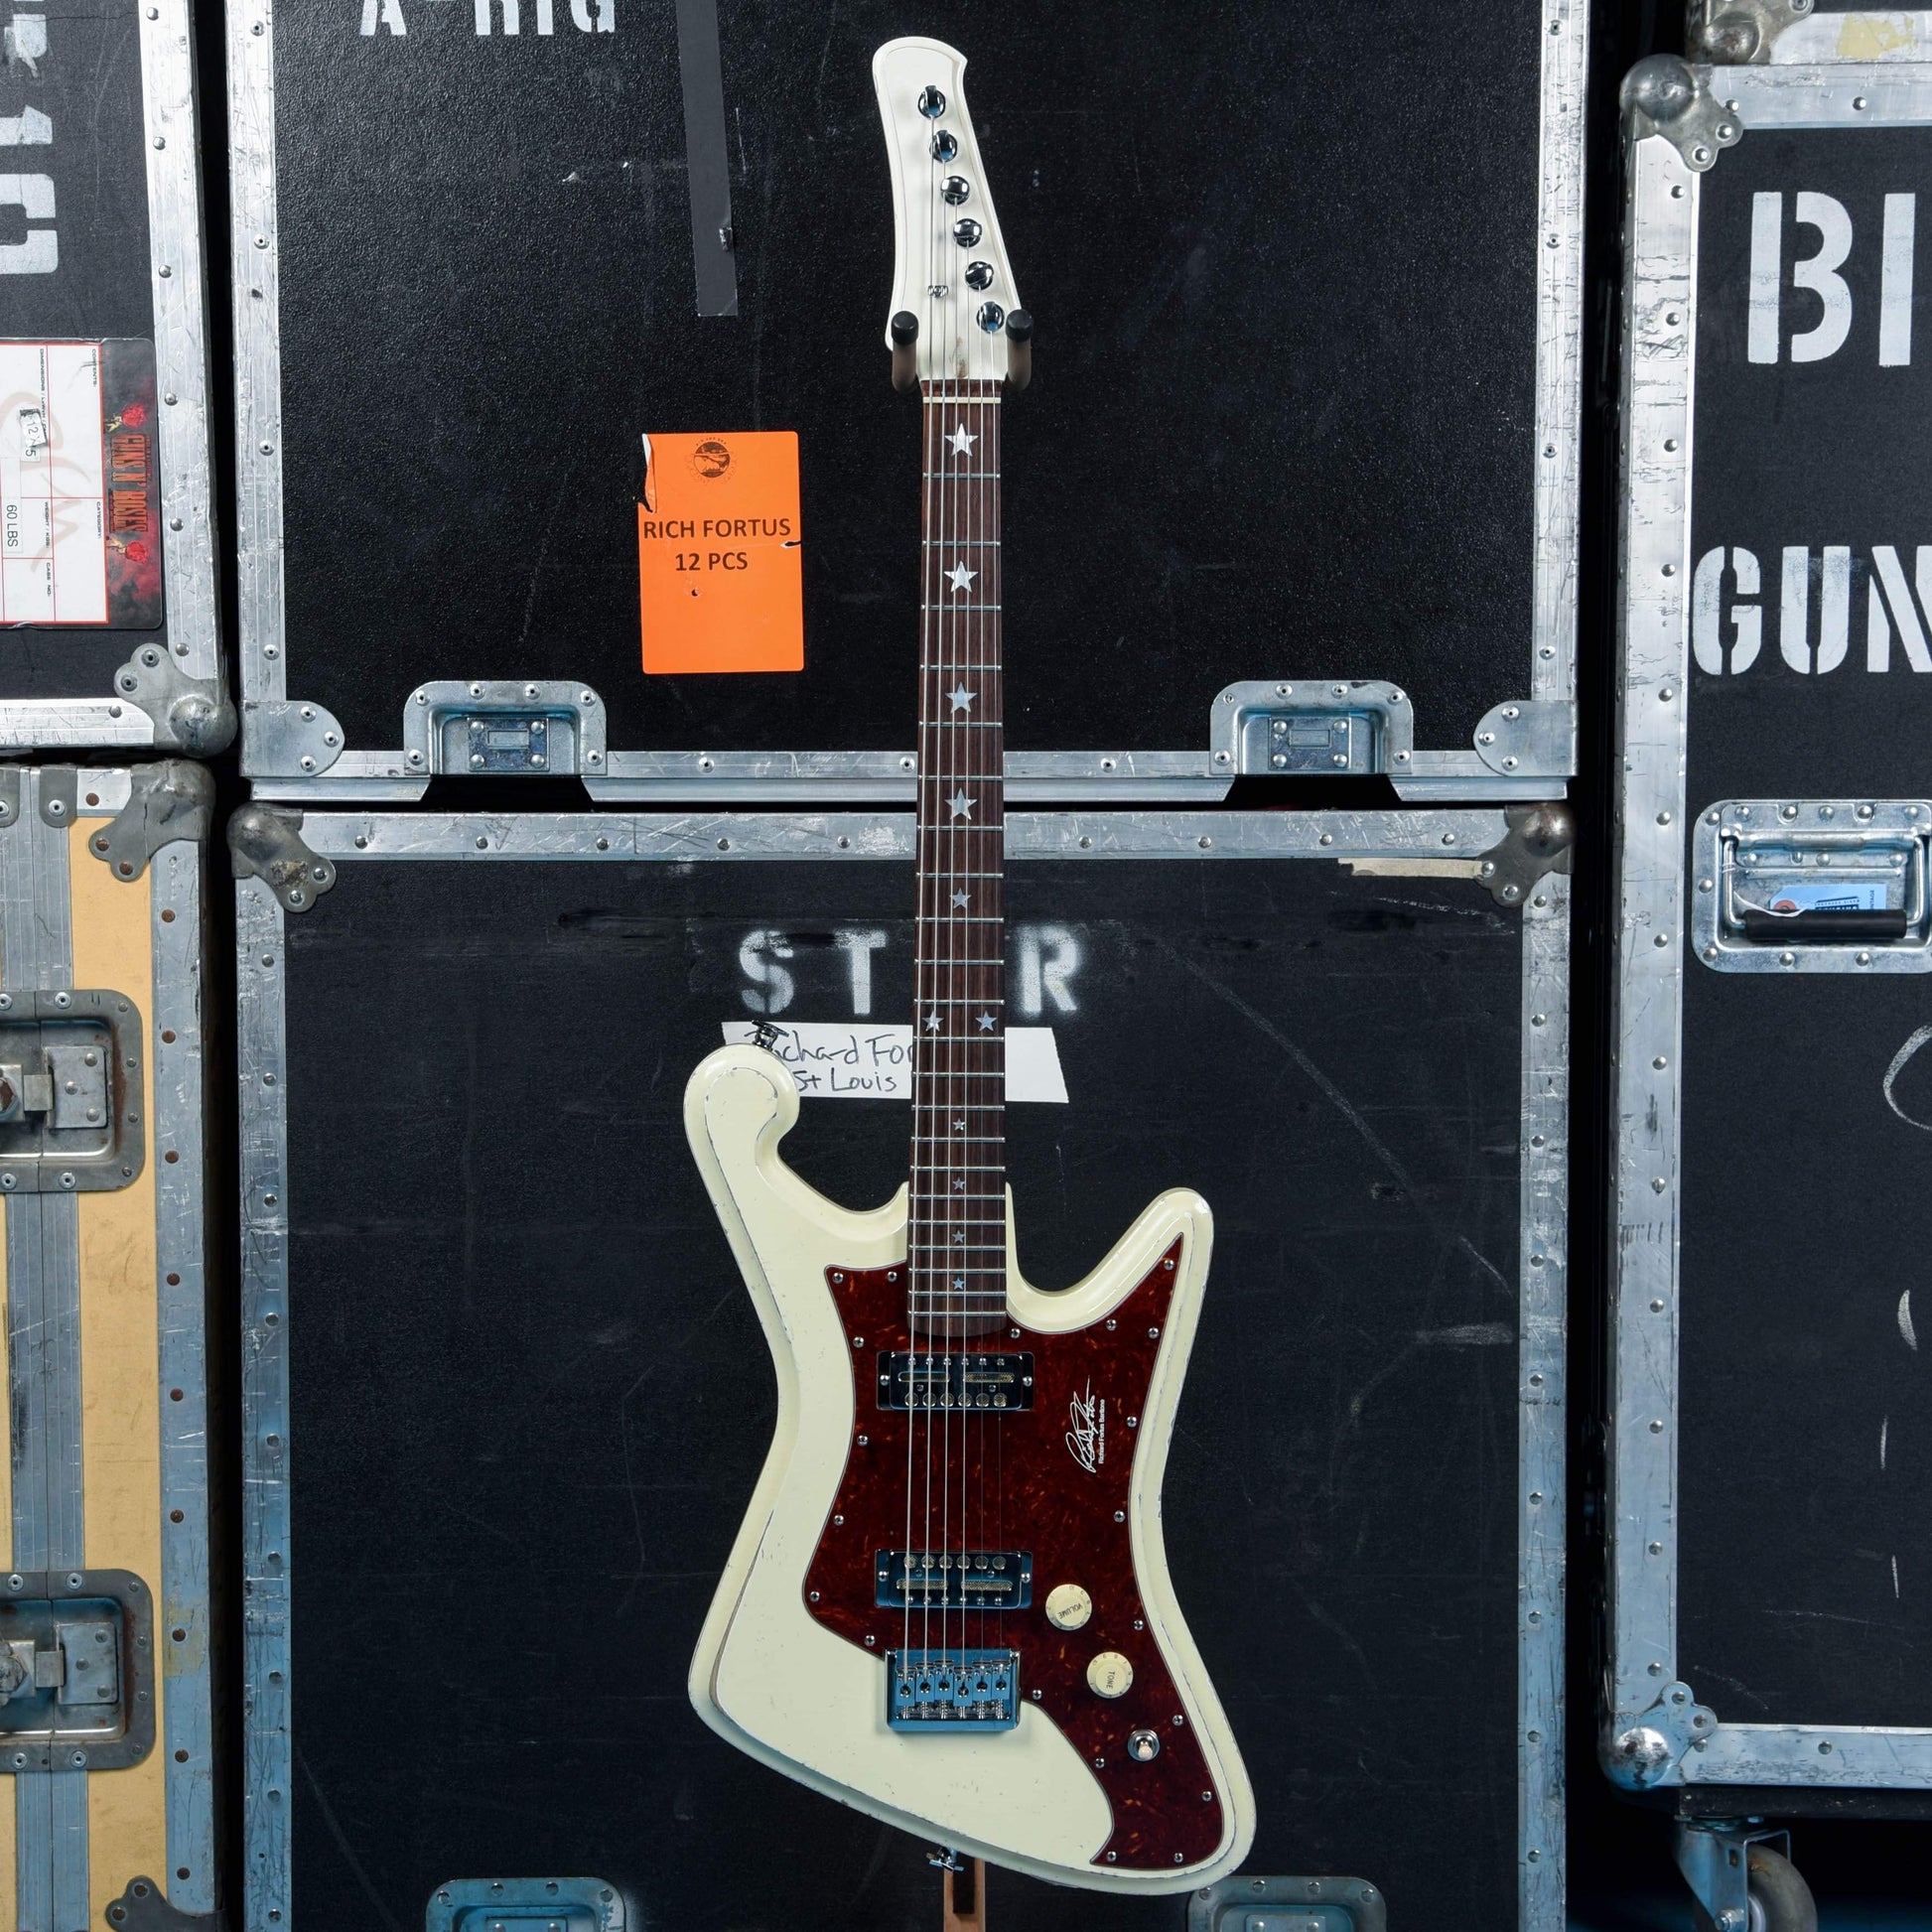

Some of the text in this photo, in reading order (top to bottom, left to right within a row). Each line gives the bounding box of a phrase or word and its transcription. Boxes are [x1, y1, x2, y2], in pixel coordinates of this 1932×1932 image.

[1748, 192, 1915, 366] BI
[111, 435, 147, 468] GUNS
[112, 490, 148, 532] ROSES
[6, 504, 19, 547] 60 LBS
[643, 518, 791, 539] RICH FORTUS
[675, 552, 748, 571] 12 PCS
[831, 1066, 897, 1092] Louis
[1057, 1602, 1082, 1620] VOLUME
[1106, 1671, 1115, 1690] TONE
